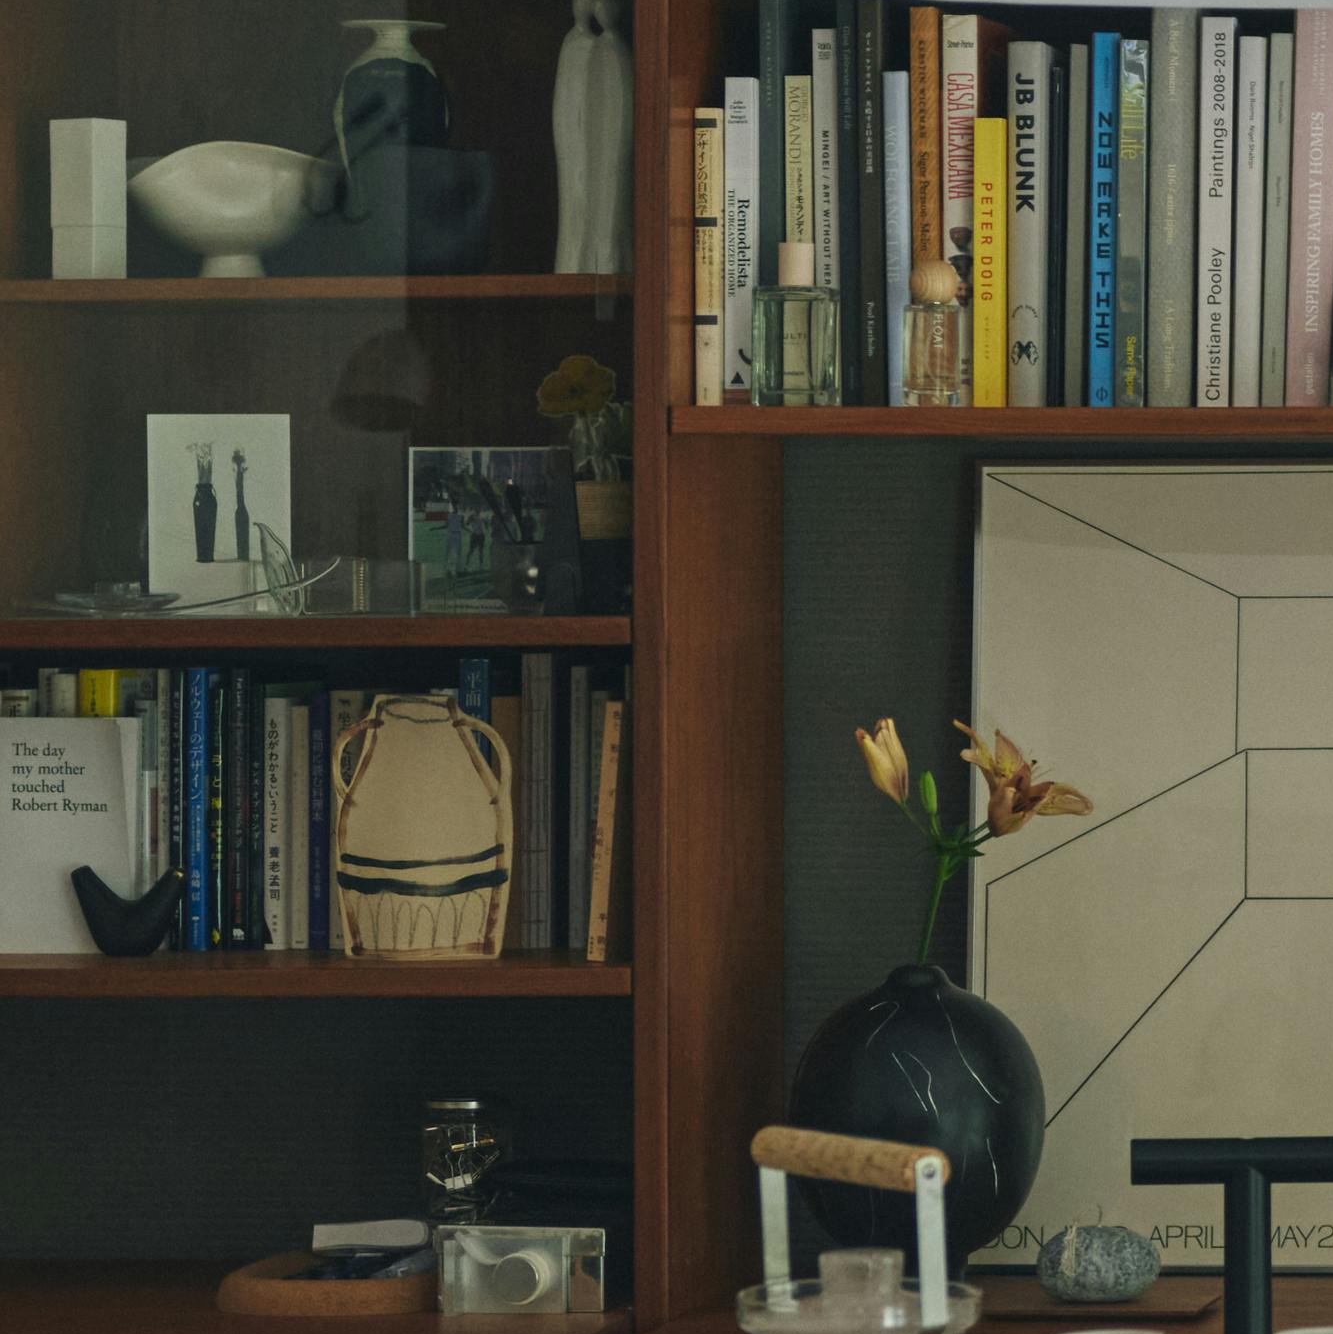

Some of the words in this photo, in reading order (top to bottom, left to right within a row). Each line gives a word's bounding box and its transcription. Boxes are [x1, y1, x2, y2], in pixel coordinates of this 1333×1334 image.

[1015, 73, 1035, 104] JB
[1213, 32, 1226, 112] 2008-2018
[1015, 113, 1035, 213] BLUNK
[1203, 118, 1224, 198] Paintings
[727, 189, 735, 206] THE
[980, 182, 993, 245] PETER
[727, 211, 735, 267] ORGANIZED
[736, 198, 750, 288] Remodelista
[727, 270, 735, 298] HOME
[980, 256, 993, 301] DOIG
[1207, 247, 1225, 305] Pooley
[1205, 313, 1223, 402] Christiane
[12, 743, 39, 756] The
[43, 743, 65, 760] day
[12, 765, 33, 778] my
[38, 761, 86, 775] mother
[12, 779, 65, 793] touched
[12, 798, 58, 812] Robert
[63, 799, 108, 815] Ryman
[1150, 1225, 1225, 1249] APRIL
